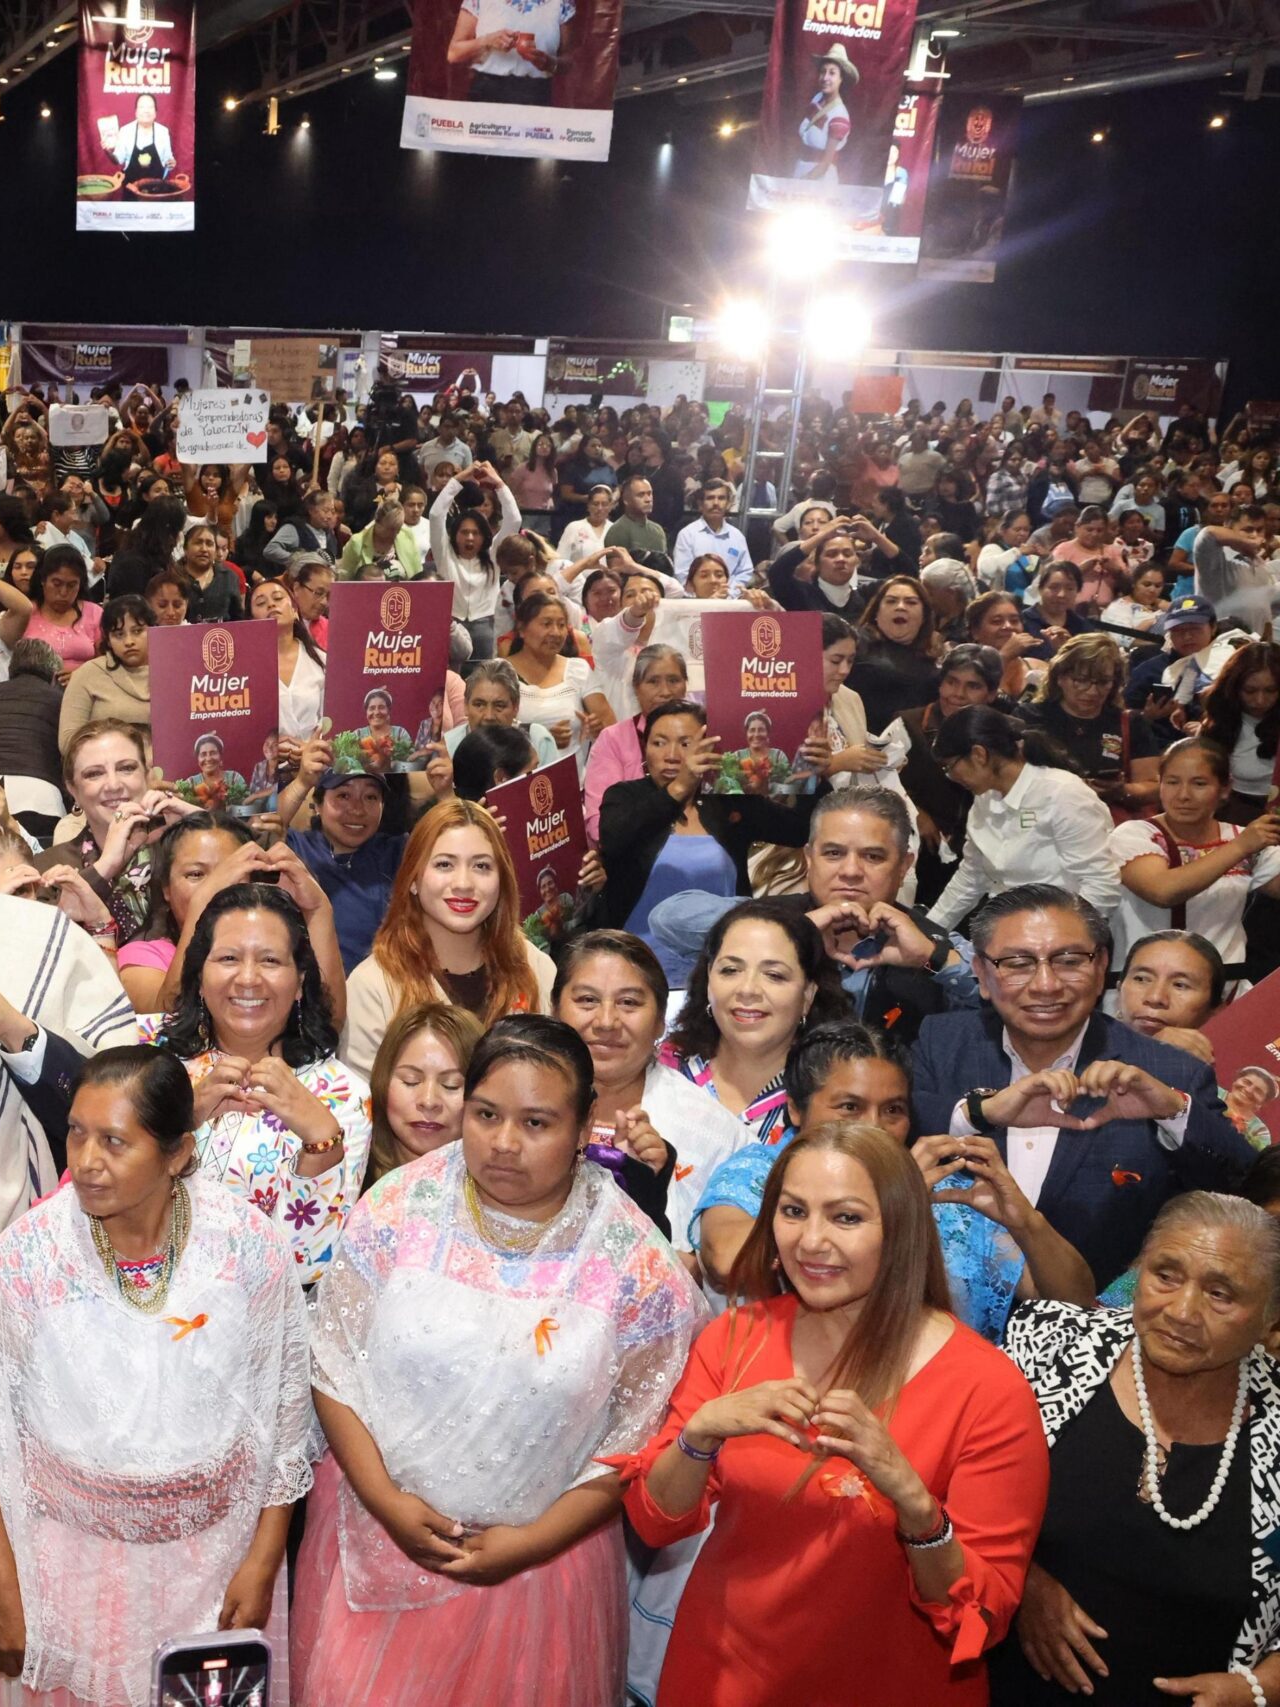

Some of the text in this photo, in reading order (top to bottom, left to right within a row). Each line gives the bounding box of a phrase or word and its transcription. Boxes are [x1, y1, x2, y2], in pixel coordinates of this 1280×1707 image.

[806, 0, 885, 28] Rural
[803, 20, 881, 40] Emprendedora
[106, 41, 170, 67] Mujer
[105, 61, 170, 85] Rural
[431, 118, 464, 129] PUEBLA
[470, 122, 506, 131] Agricultura
[566, 128, 592, 137] Pensar
[525, 131, 554, 141] PUEBLA
[567, 135, 596, 143] Grande
[954, 143, 997, 161] Mujer
[76, 344, 112, 357] Mujer
[407, 352, 441, 366] Mujer
[76, 354, 112, 366] Rural
[406, 363, 440, 375] Rural
[1150, 374, 1179, 388] Mujer
[181, 391, 226, 416] Mujeres
[366, 631, 421, 653] Mujer
[365, 646, 421, 667] Rural
[363, 666, 421, 675] Emprendedora
[741, 657, 795, 678] Mujer
[191, 673, 248, 696] Mujer
[741, 672, 796, 690] Rural
[190, 688, 250, 712] Rural
[741, 689, 798, 698] Emprendedora
[190, 709, 251, 720] Emprendedora
[526, 809, 565, 838] Mujer
[528, 819, 568, 853] Rural
